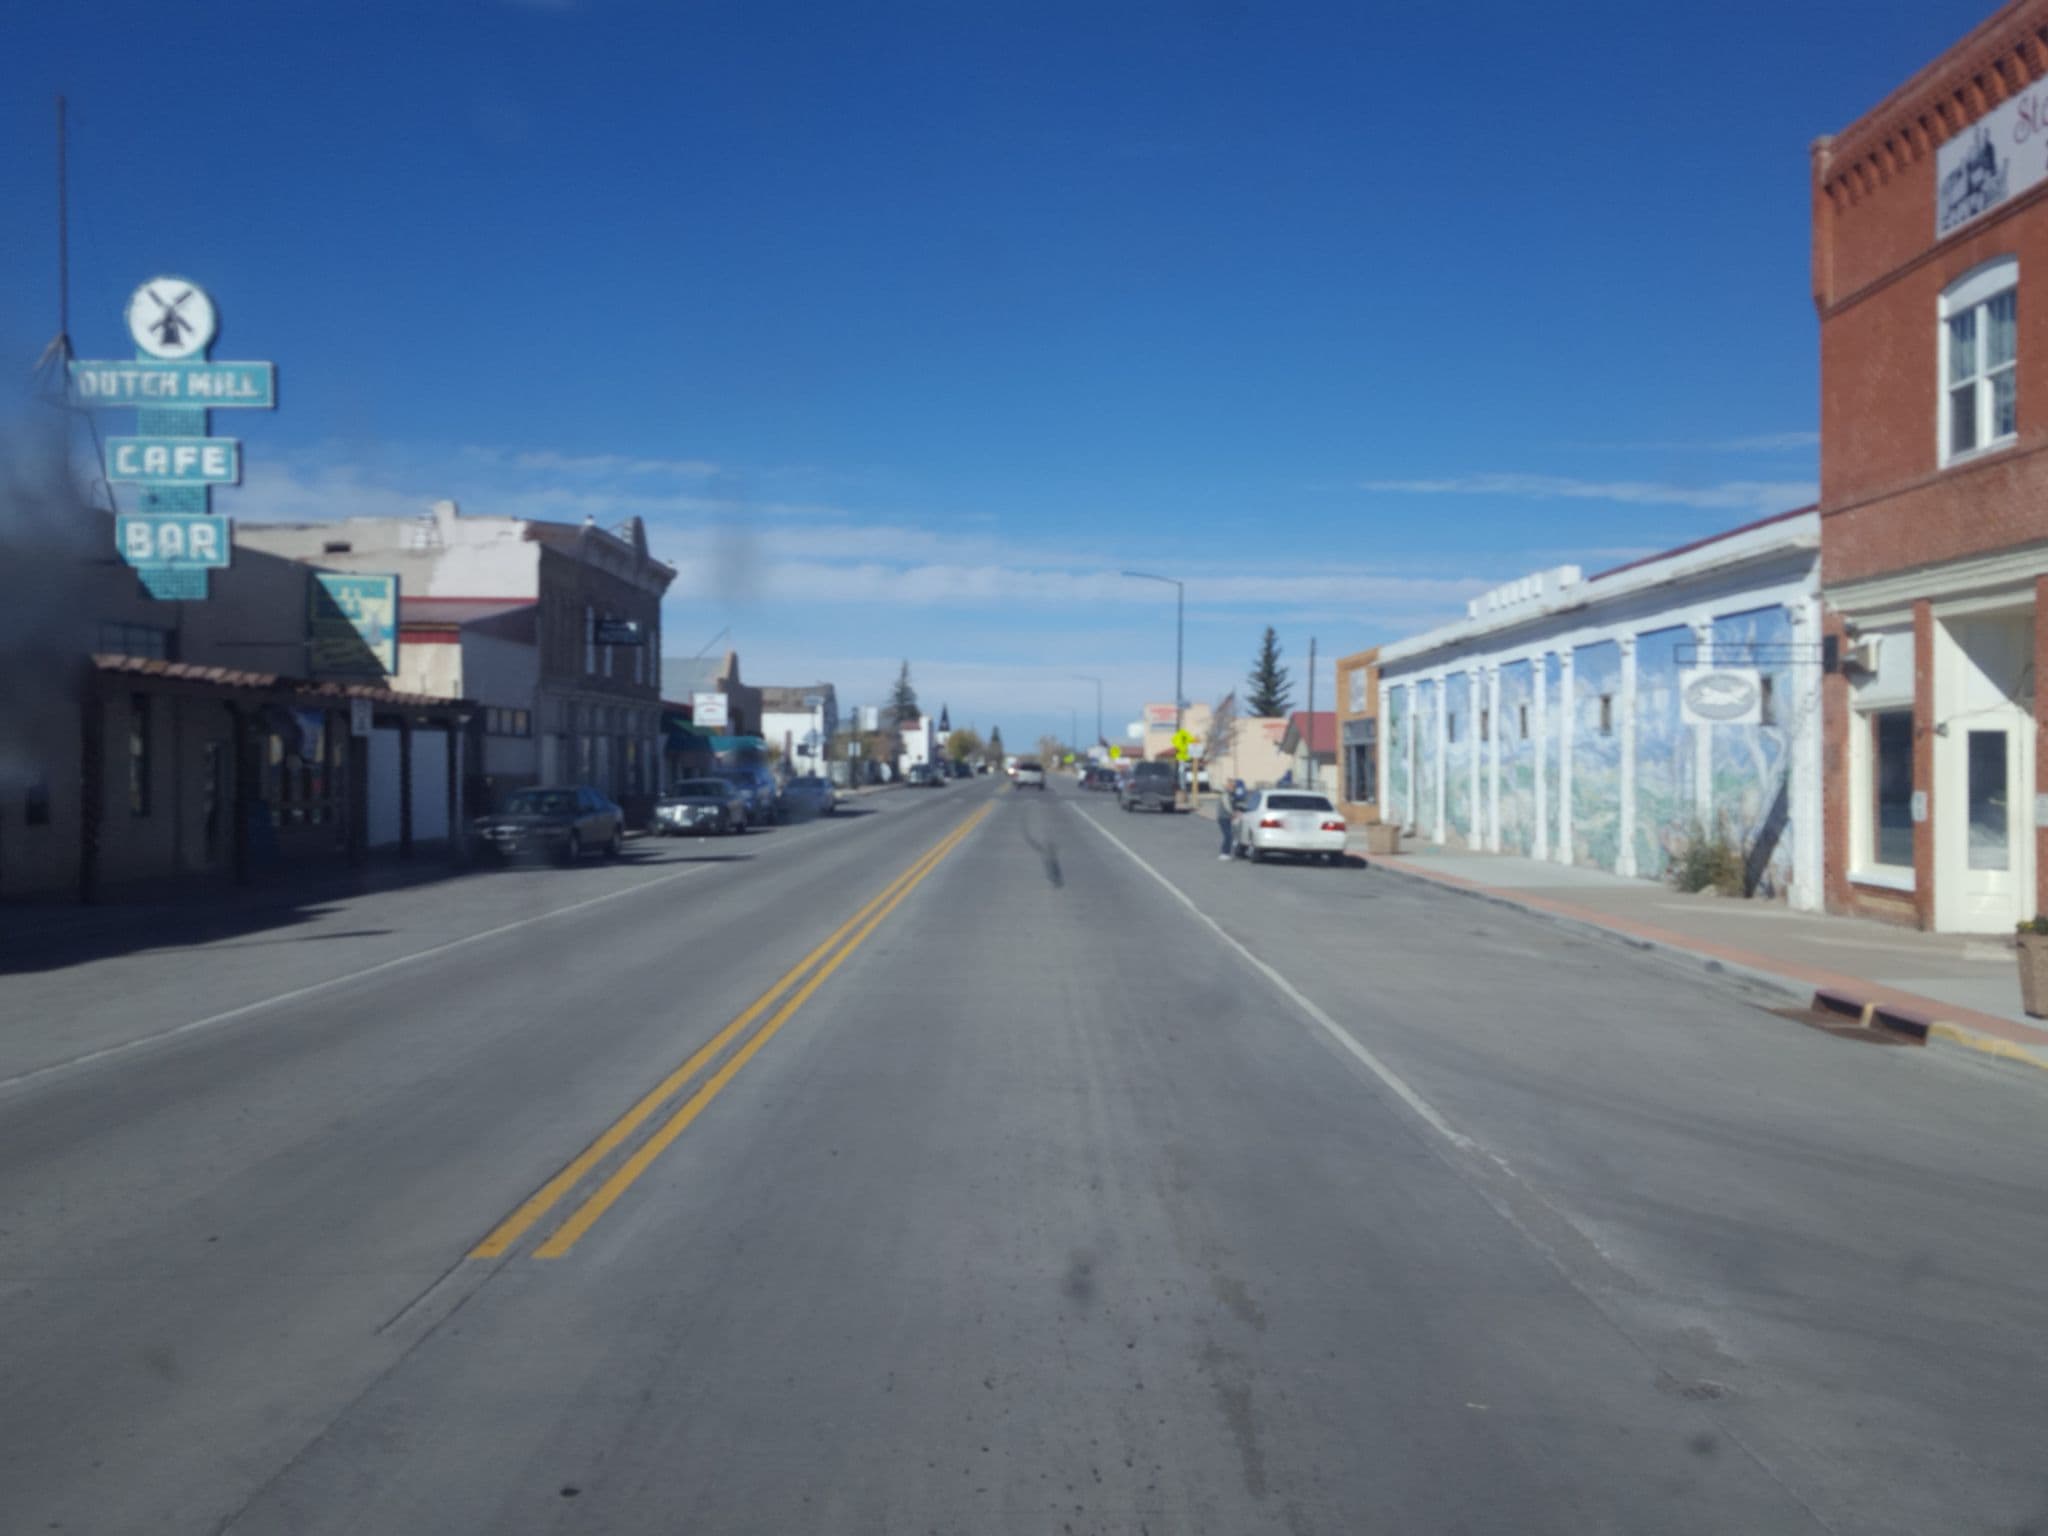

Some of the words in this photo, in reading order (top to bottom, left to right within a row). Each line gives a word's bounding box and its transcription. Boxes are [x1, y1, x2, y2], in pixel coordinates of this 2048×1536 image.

[79, 371, 180, 397] DUTCH
[187, 371, 259, 397] MILL
[115, 445, 227, 476] CAFE
[125, 521, 218, 560] BAR
